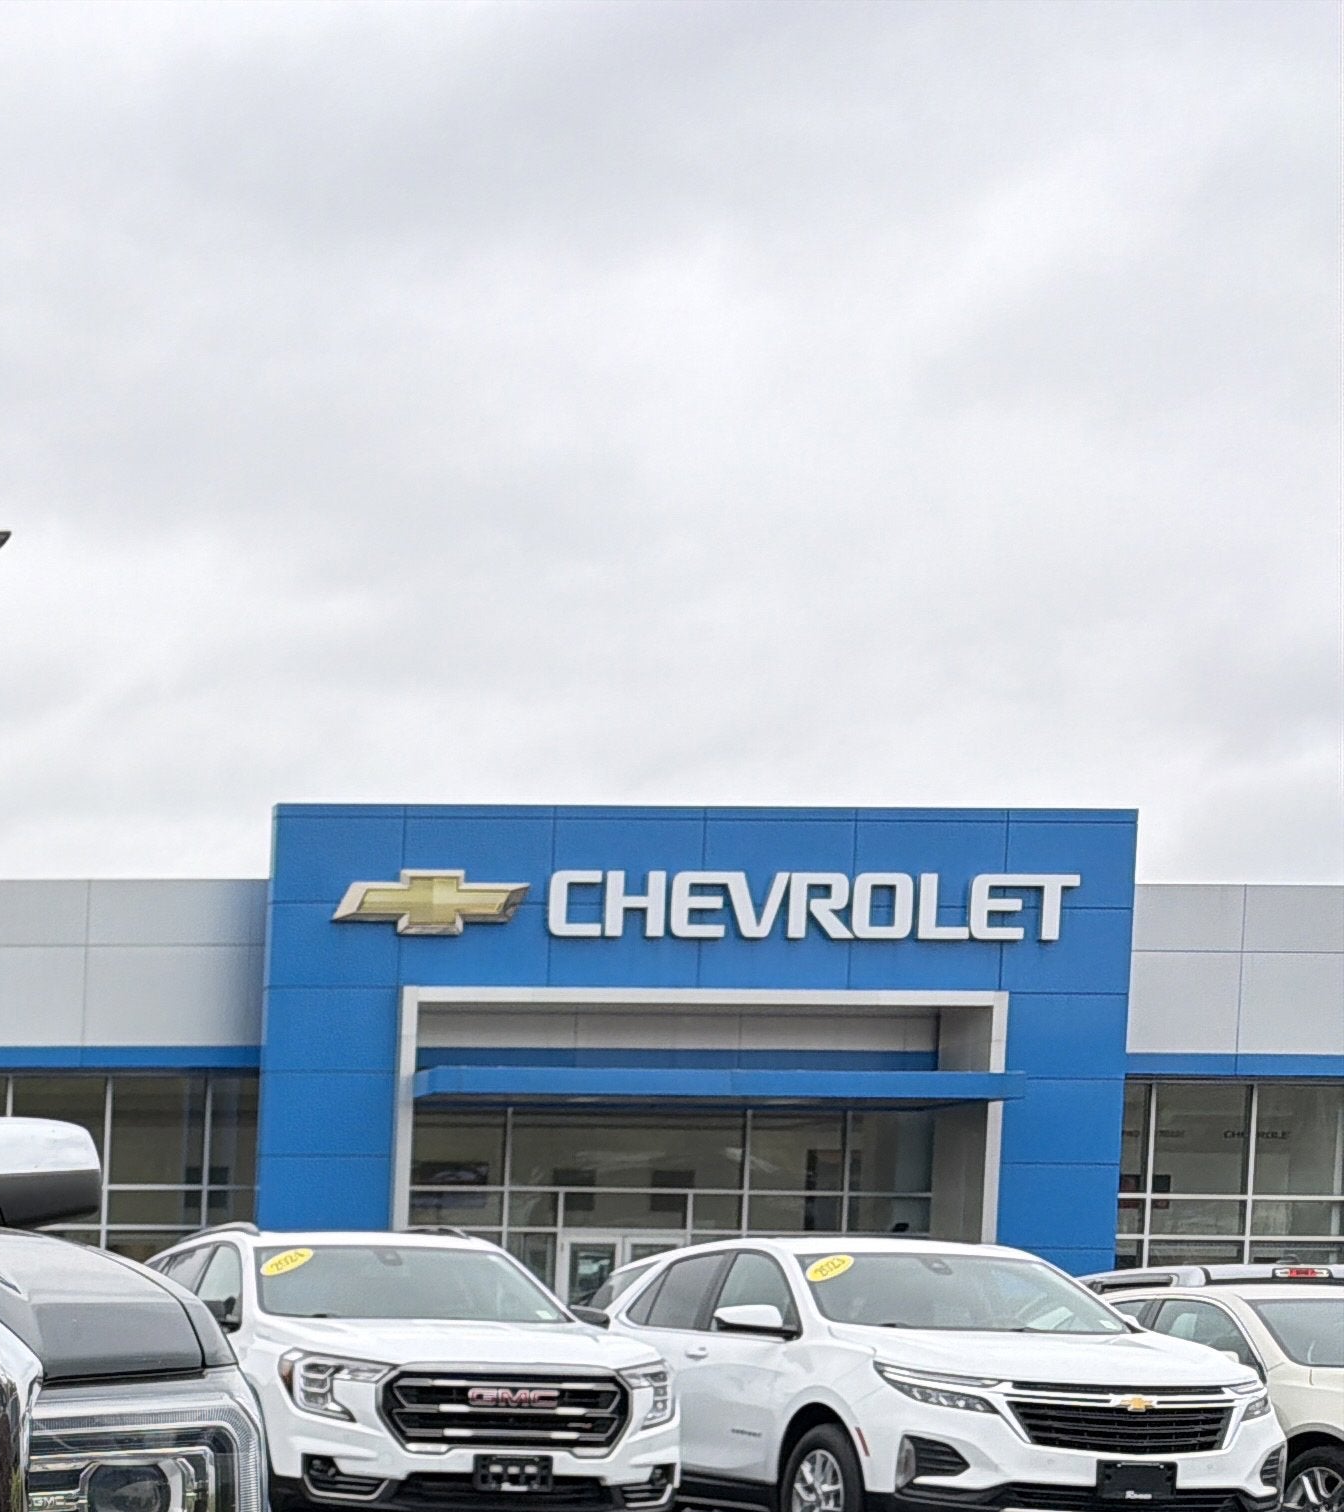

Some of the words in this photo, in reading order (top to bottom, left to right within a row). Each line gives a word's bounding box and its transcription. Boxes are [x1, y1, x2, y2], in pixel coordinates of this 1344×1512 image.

[548, 870, 1082, 941] CHEVROLET
[468, 1387, 560, 1408] GMC
[32, 1495, 64, 1507] GMC
